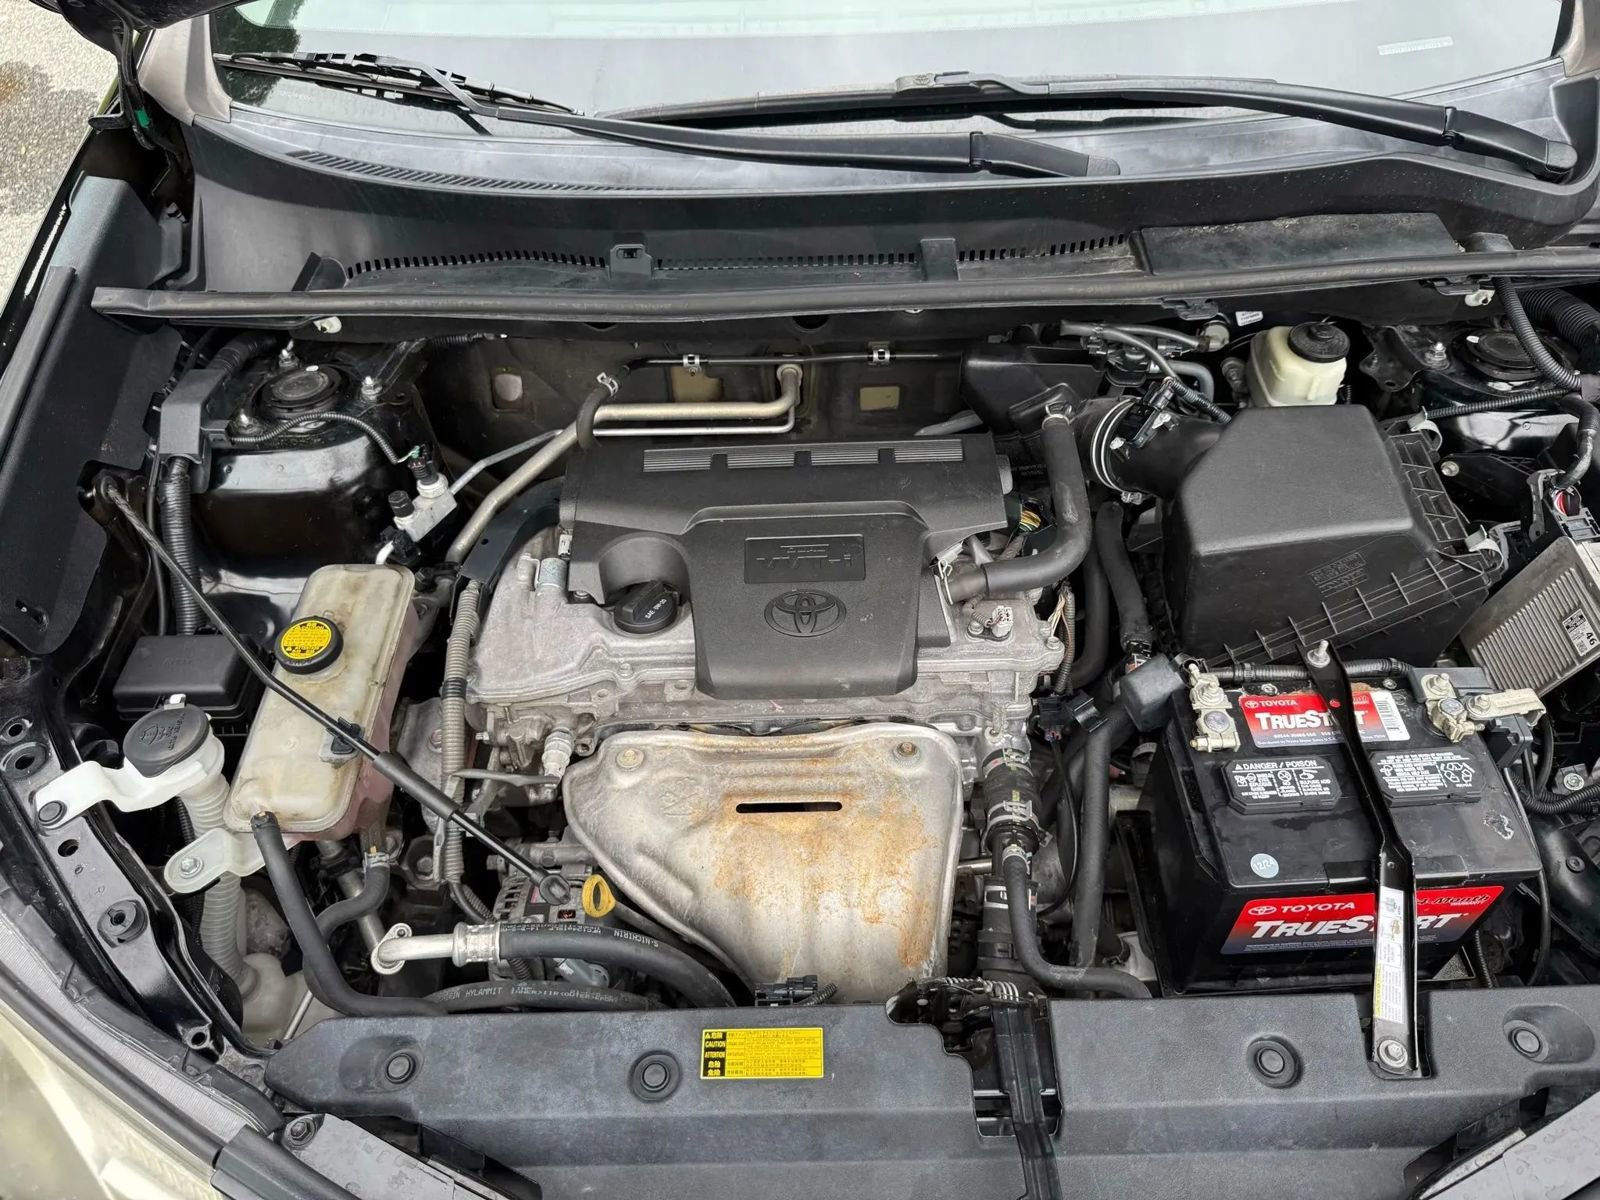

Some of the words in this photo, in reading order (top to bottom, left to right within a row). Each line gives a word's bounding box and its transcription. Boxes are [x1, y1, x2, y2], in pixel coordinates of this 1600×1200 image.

[1585, 632, 1598, 646] 46
[1259, 699, 1298, 707] TOYOTA
[1242, 762, 1278, 770] DANGER
[1285, 760, 1318, 768] POISON
[1280, 902, 1356, 913] TOYOTA
